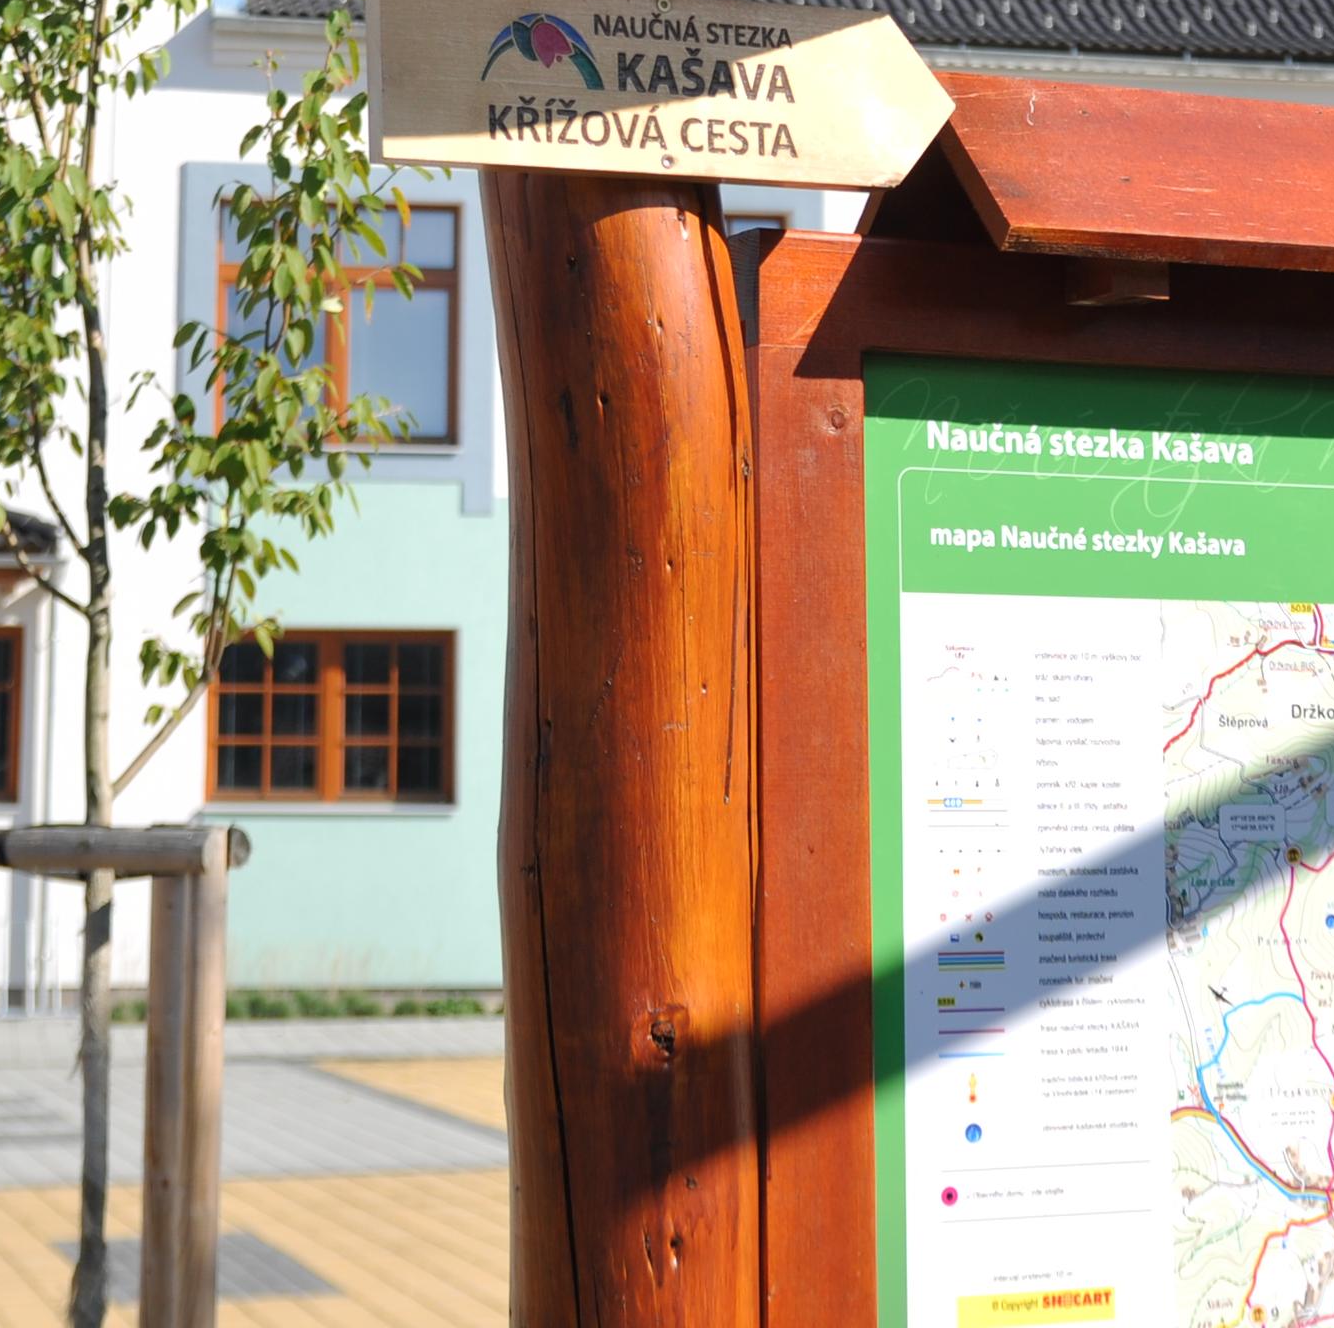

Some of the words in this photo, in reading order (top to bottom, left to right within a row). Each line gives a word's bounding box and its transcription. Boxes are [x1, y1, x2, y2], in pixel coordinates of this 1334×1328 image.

[593, 12, 700, 44] NAUČNÁ
[706, 22, 793, 50] STEZKA
[617, 47, 796, 104] KAŠAVA
[488, 95, 668, 150] KŘÍŽOVÁ
[680, 116, 799, 159] CESTA
[926, 420, 1042, 456] Naučná
[1049, 429, 1145, 460] stezka
[1152, 432, 1254, 465] Kašava
[930, 527, 996, 553] mapa
[1001, 525, 1087, 551] Naučné
[1092, 529, 1164, 559] stezky
[1168, 531, 1246, 556] Kašava
